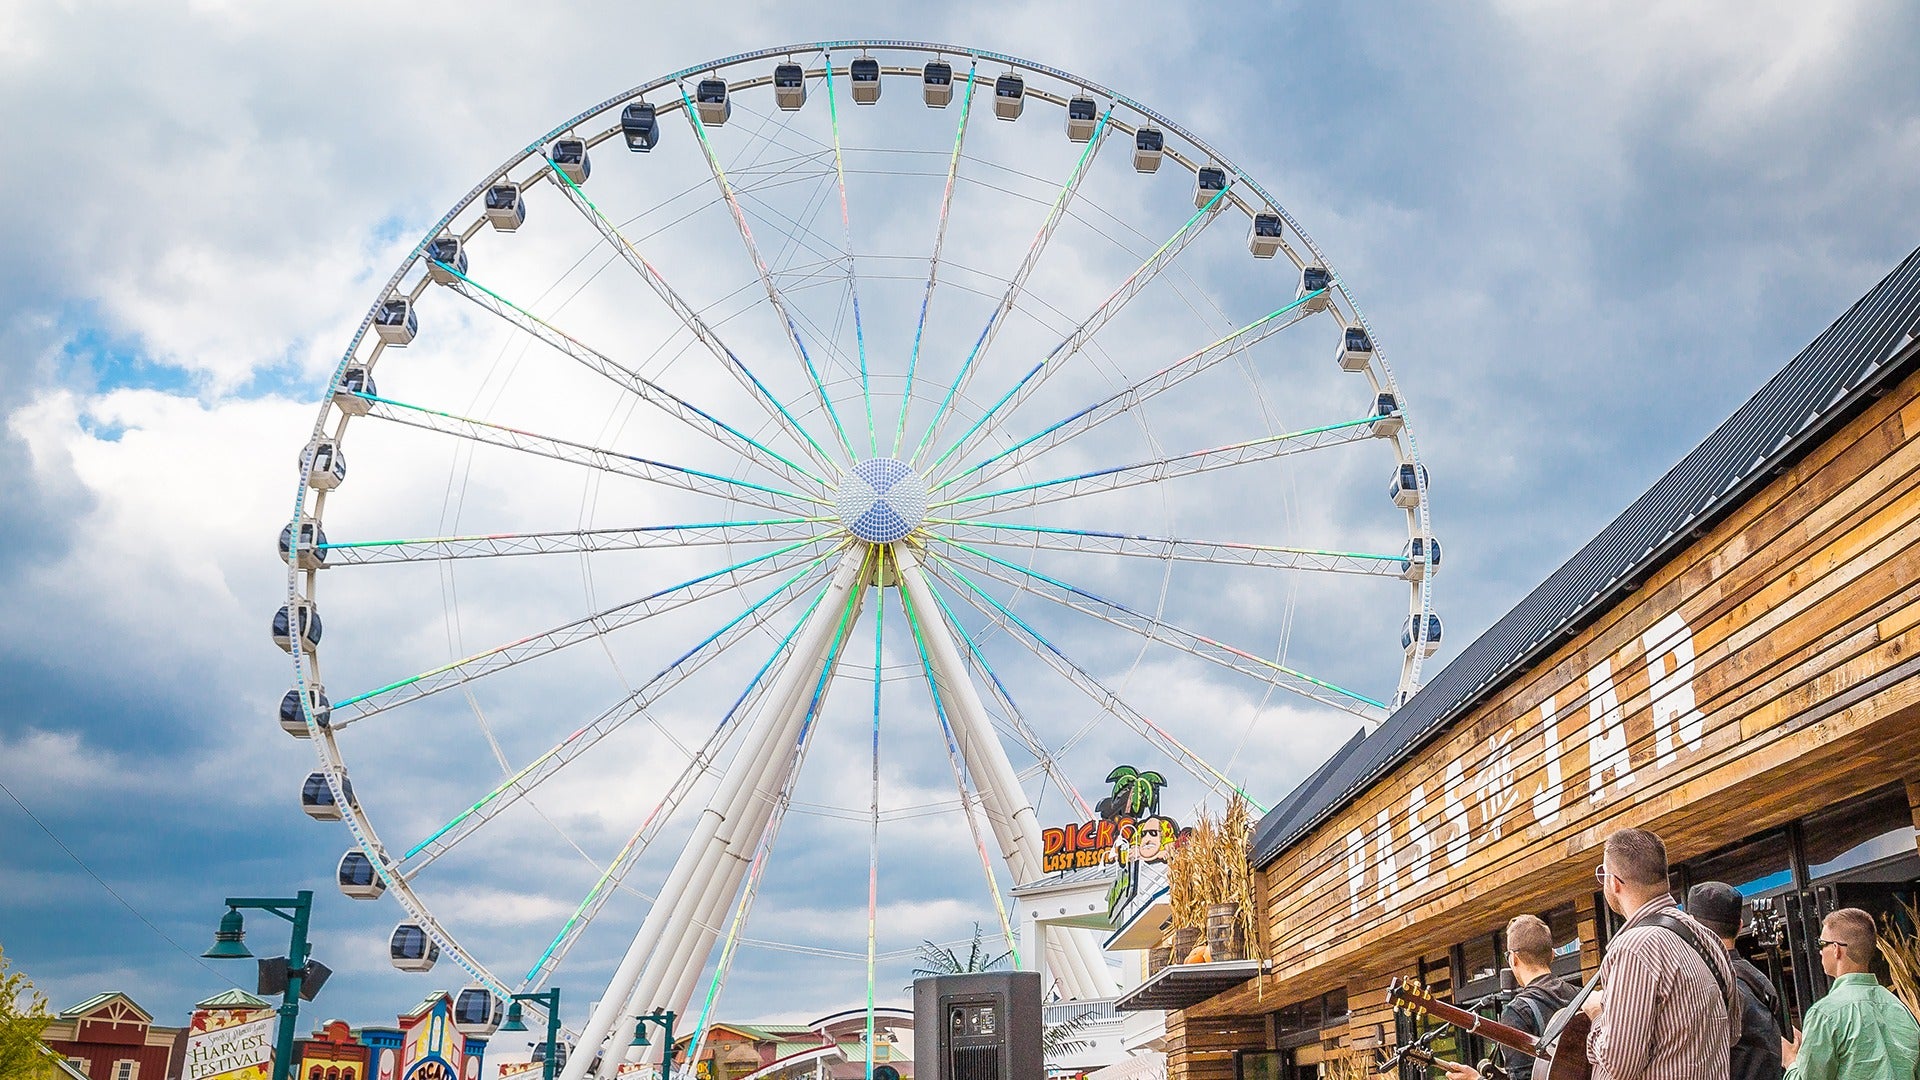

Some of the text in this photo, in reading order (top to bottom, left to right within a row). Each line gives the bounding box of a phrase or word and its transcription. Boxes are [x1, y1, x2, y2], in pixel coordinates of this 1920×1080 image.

[1346, 757, 1471, 919] PASS
[1532, 611, 1705, 827] JAR
[1043, 817, 1135, 855] DICK'S
[1043, 852, 1075, 873] LAST
[193, 1033, 265, 1062] HARVEST
[190, 1051, 264, 1078] FESTIVAL
